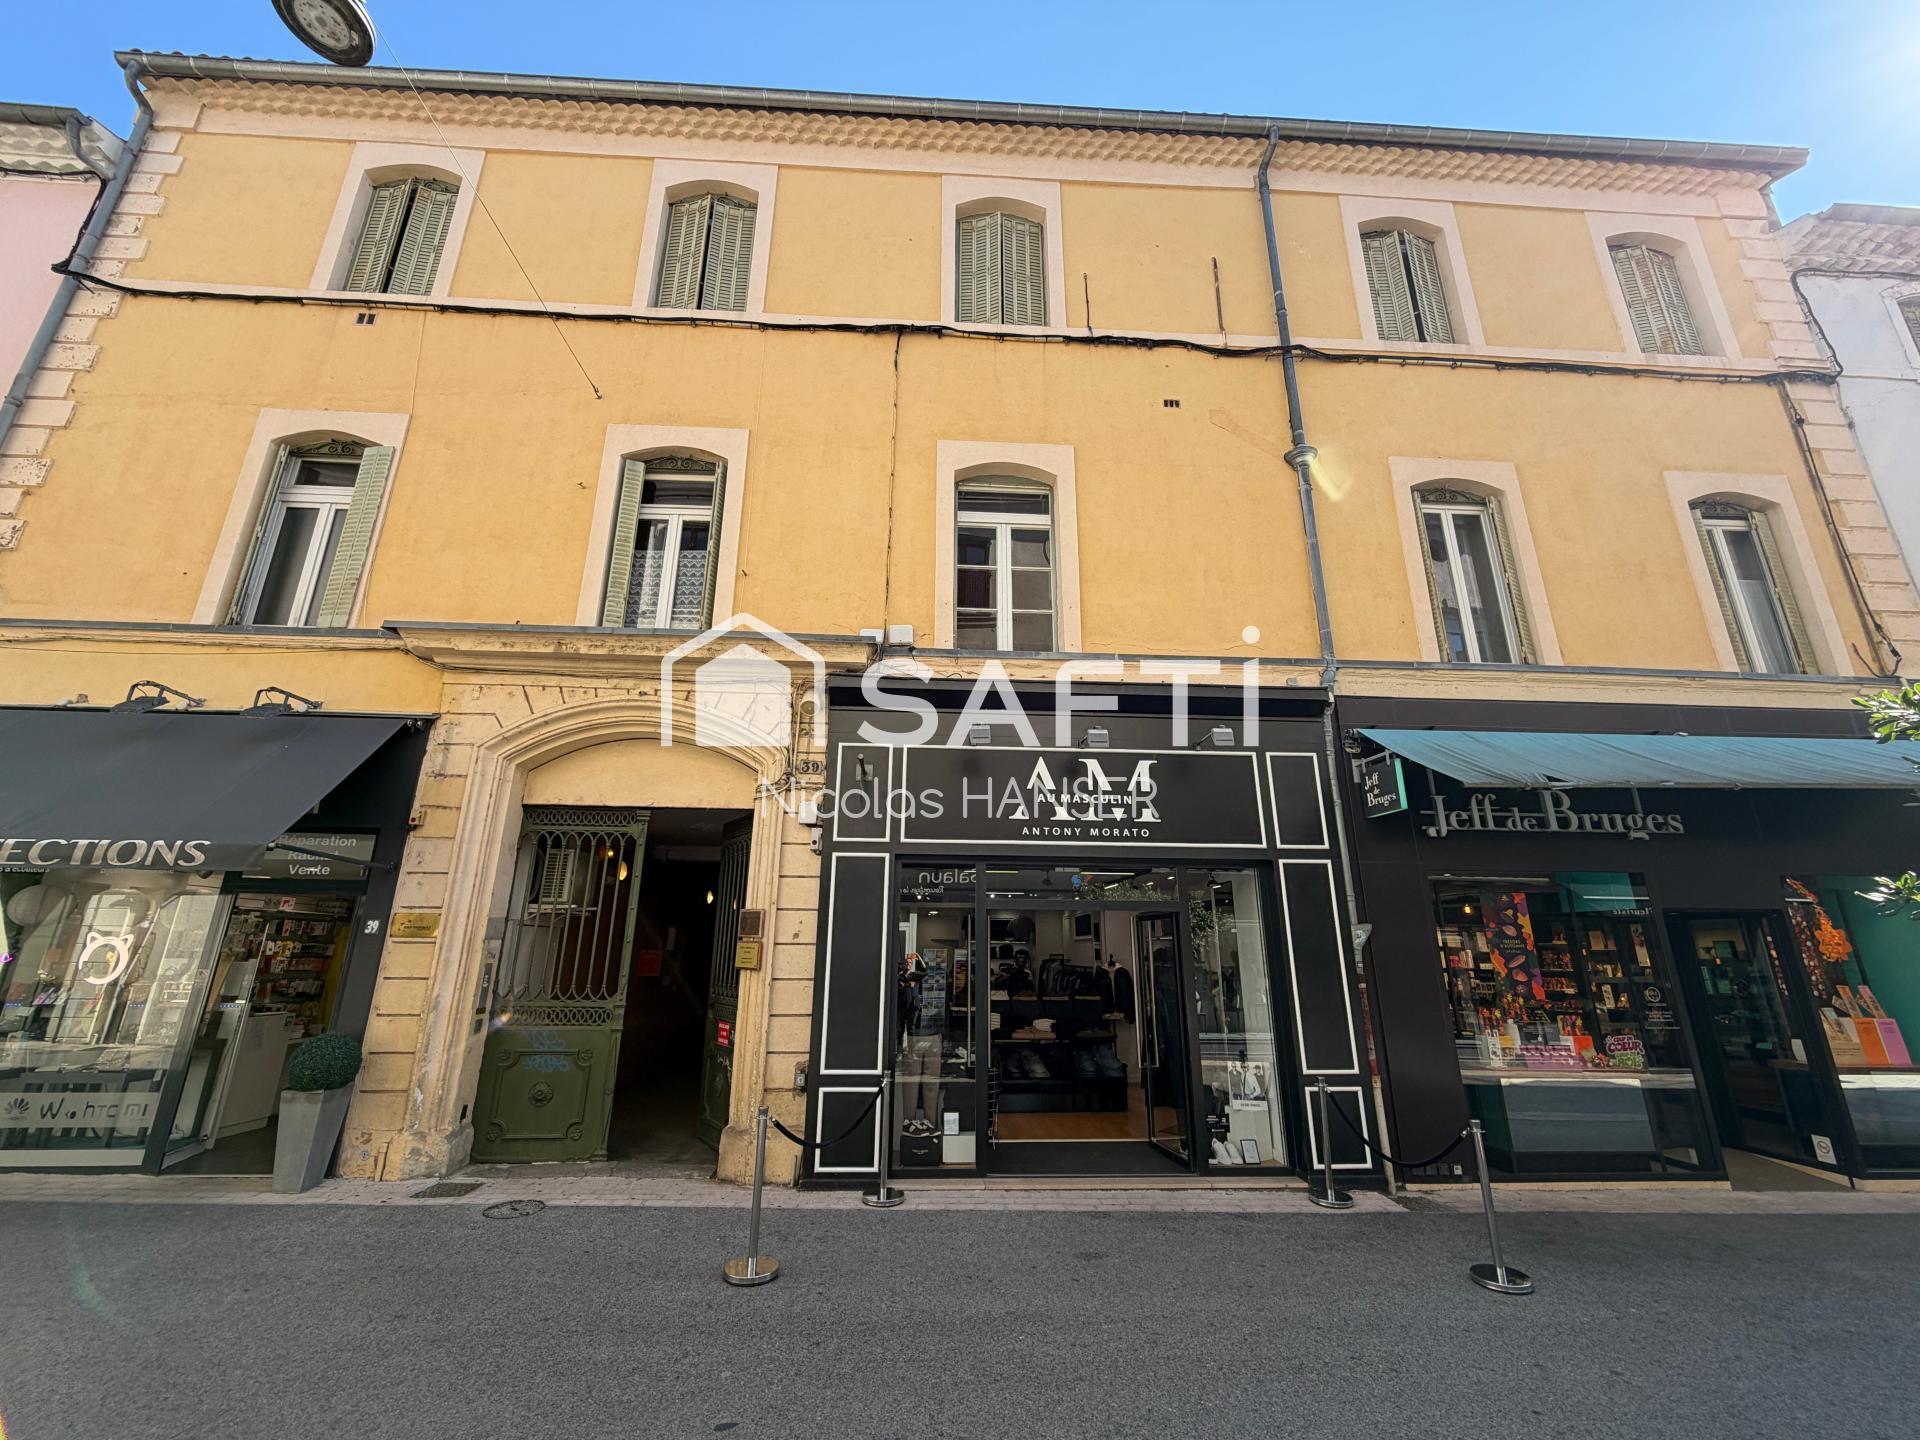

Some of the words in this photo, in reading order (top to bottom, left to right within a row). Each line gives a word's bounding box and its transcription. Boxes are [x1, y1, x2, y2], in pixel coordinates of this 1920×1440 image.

[801, 761, 820, 773] 39
[1364, 771, 1379, 790] Jeff
[1373, 786, 1380, 795] de
[1037, 794, 1057, 803] AU
[1060, 794, 1133, 804] MASCULIN
[1366, 792, 1397, 807] Bruges
[1426, 793, 1497, 837] Jeff
[1506, 807, 1538, 831] de
[1540, 790, 1684, 841] Bruges
[1022, 827, 1081, 836] ANTONY
[1089, 828, 1150, 837] MORATO
[279, 835, 357, 848] Réparation
[0, 838, 212, 867] ECTIONS
[289, 864, 331, 875] Vente
[364, 920, 380, 934] 39
[1607, 1041, 1644, 1054] COEUR
